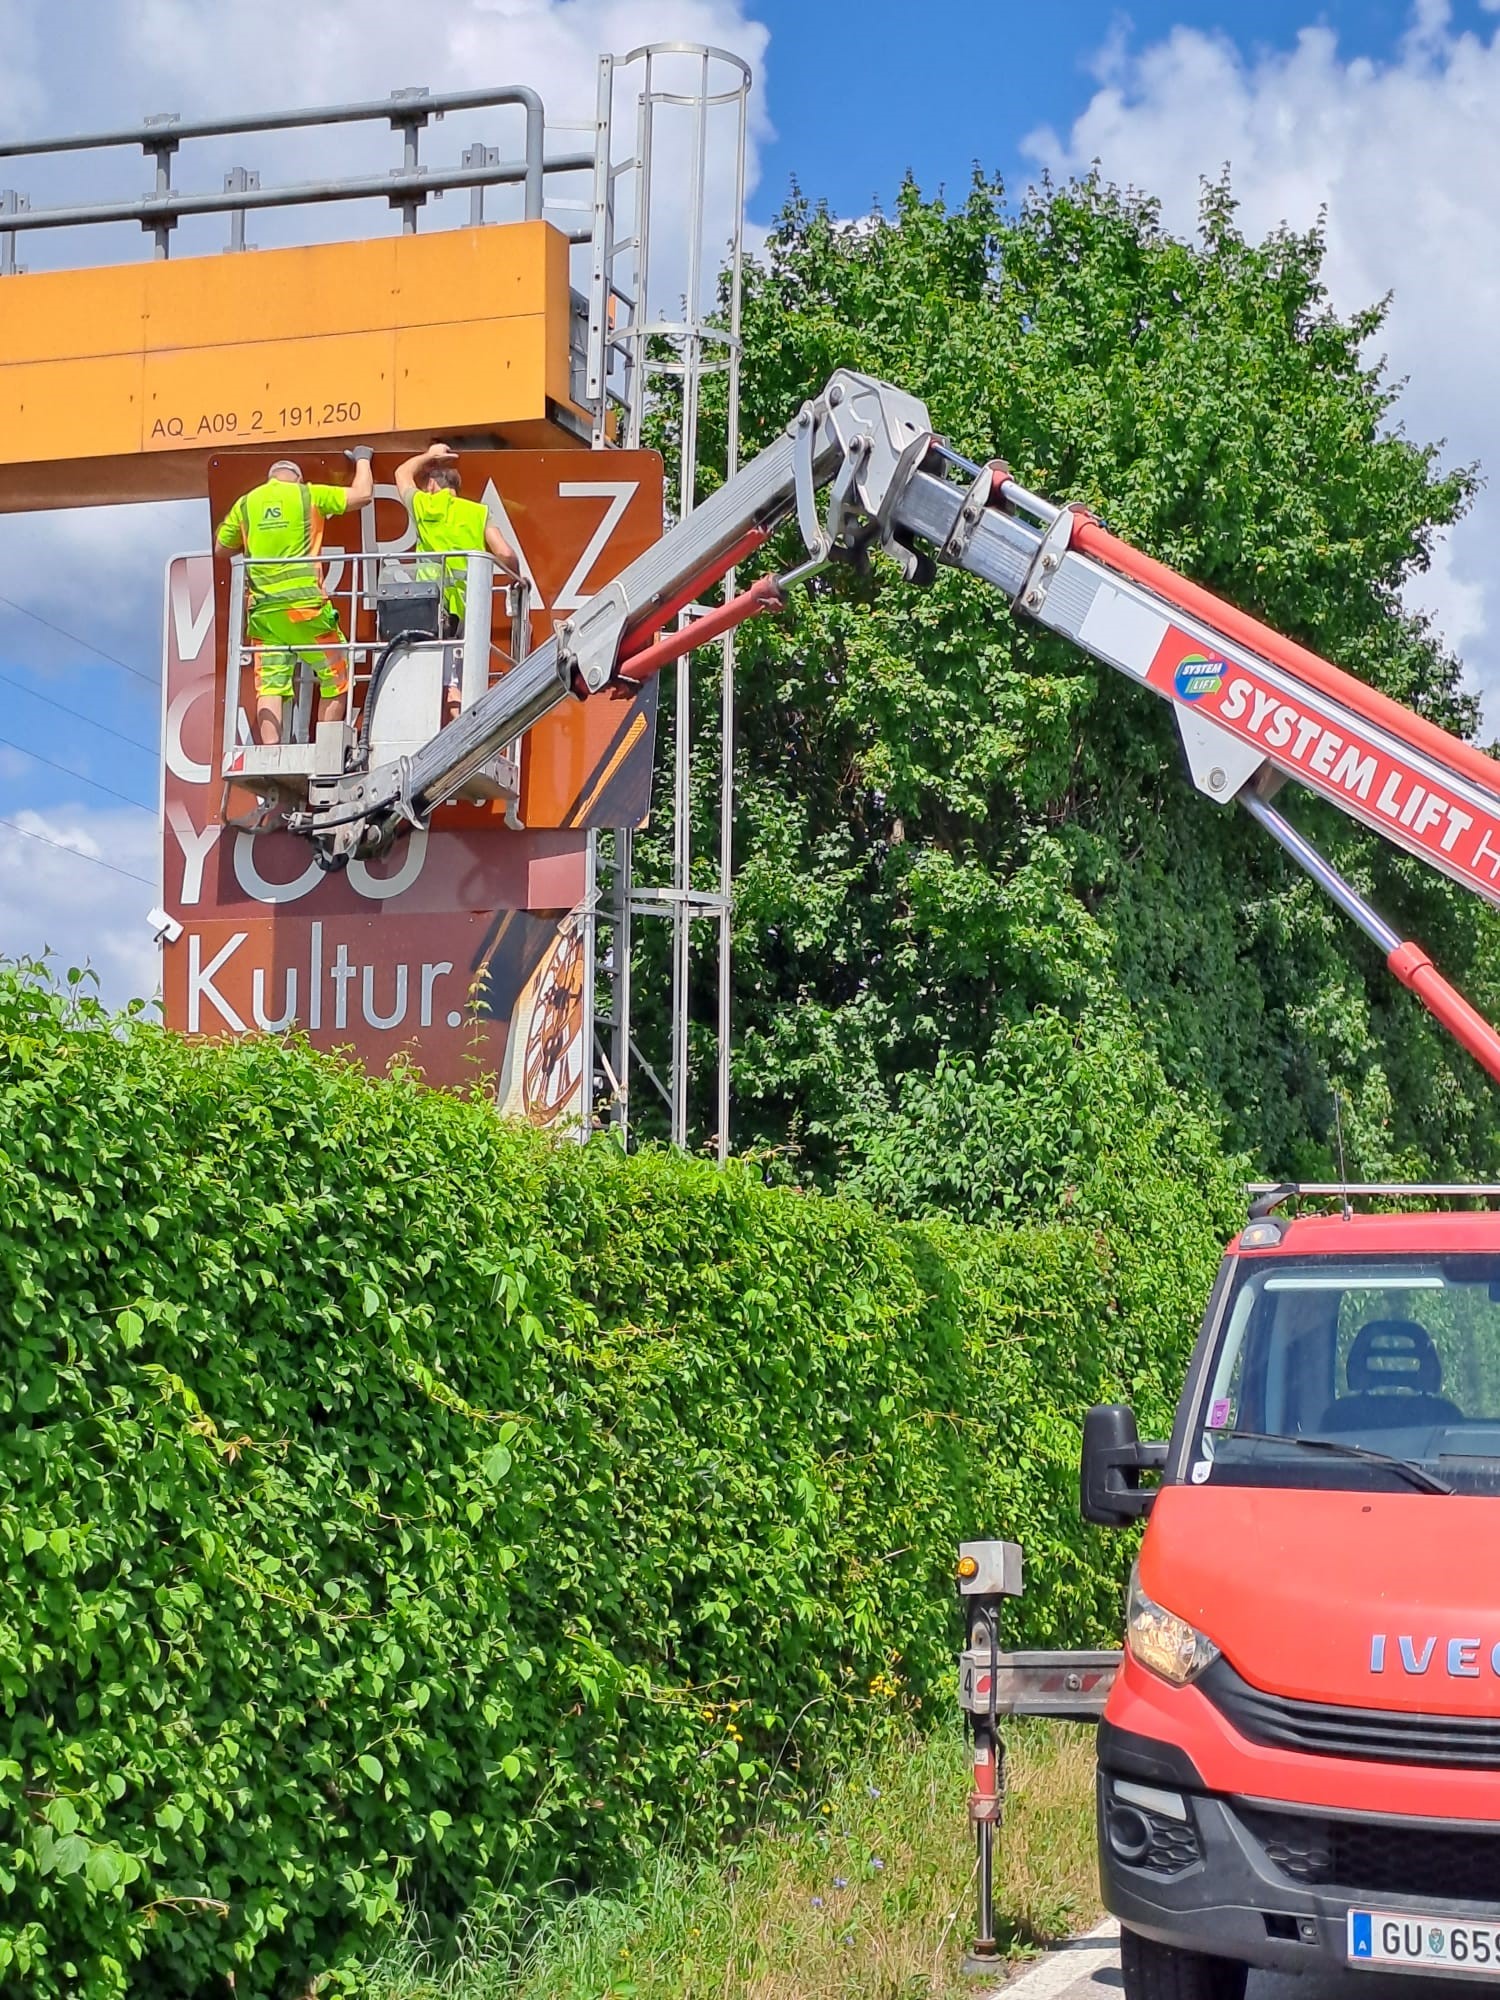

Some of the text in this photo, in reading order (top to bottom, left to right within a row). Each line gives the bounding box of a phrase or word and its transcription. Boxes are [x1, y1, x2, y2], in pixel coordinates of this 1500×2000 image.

[151, 402, 362, 440] AQ_A09_2_191,250
[1181, 662, 1223, 676] SYSTEM
[1193, 679, 1216, 690] LIFT
[1219, 679, 1379, 801] SYSTEM
[1375, 770, 1474, 852] LIFT
[188, 921, 462, 1033] Kultur.
[963, 1668, 973, 1700] 4
[1382, 1922, 1422, 1956] GU
